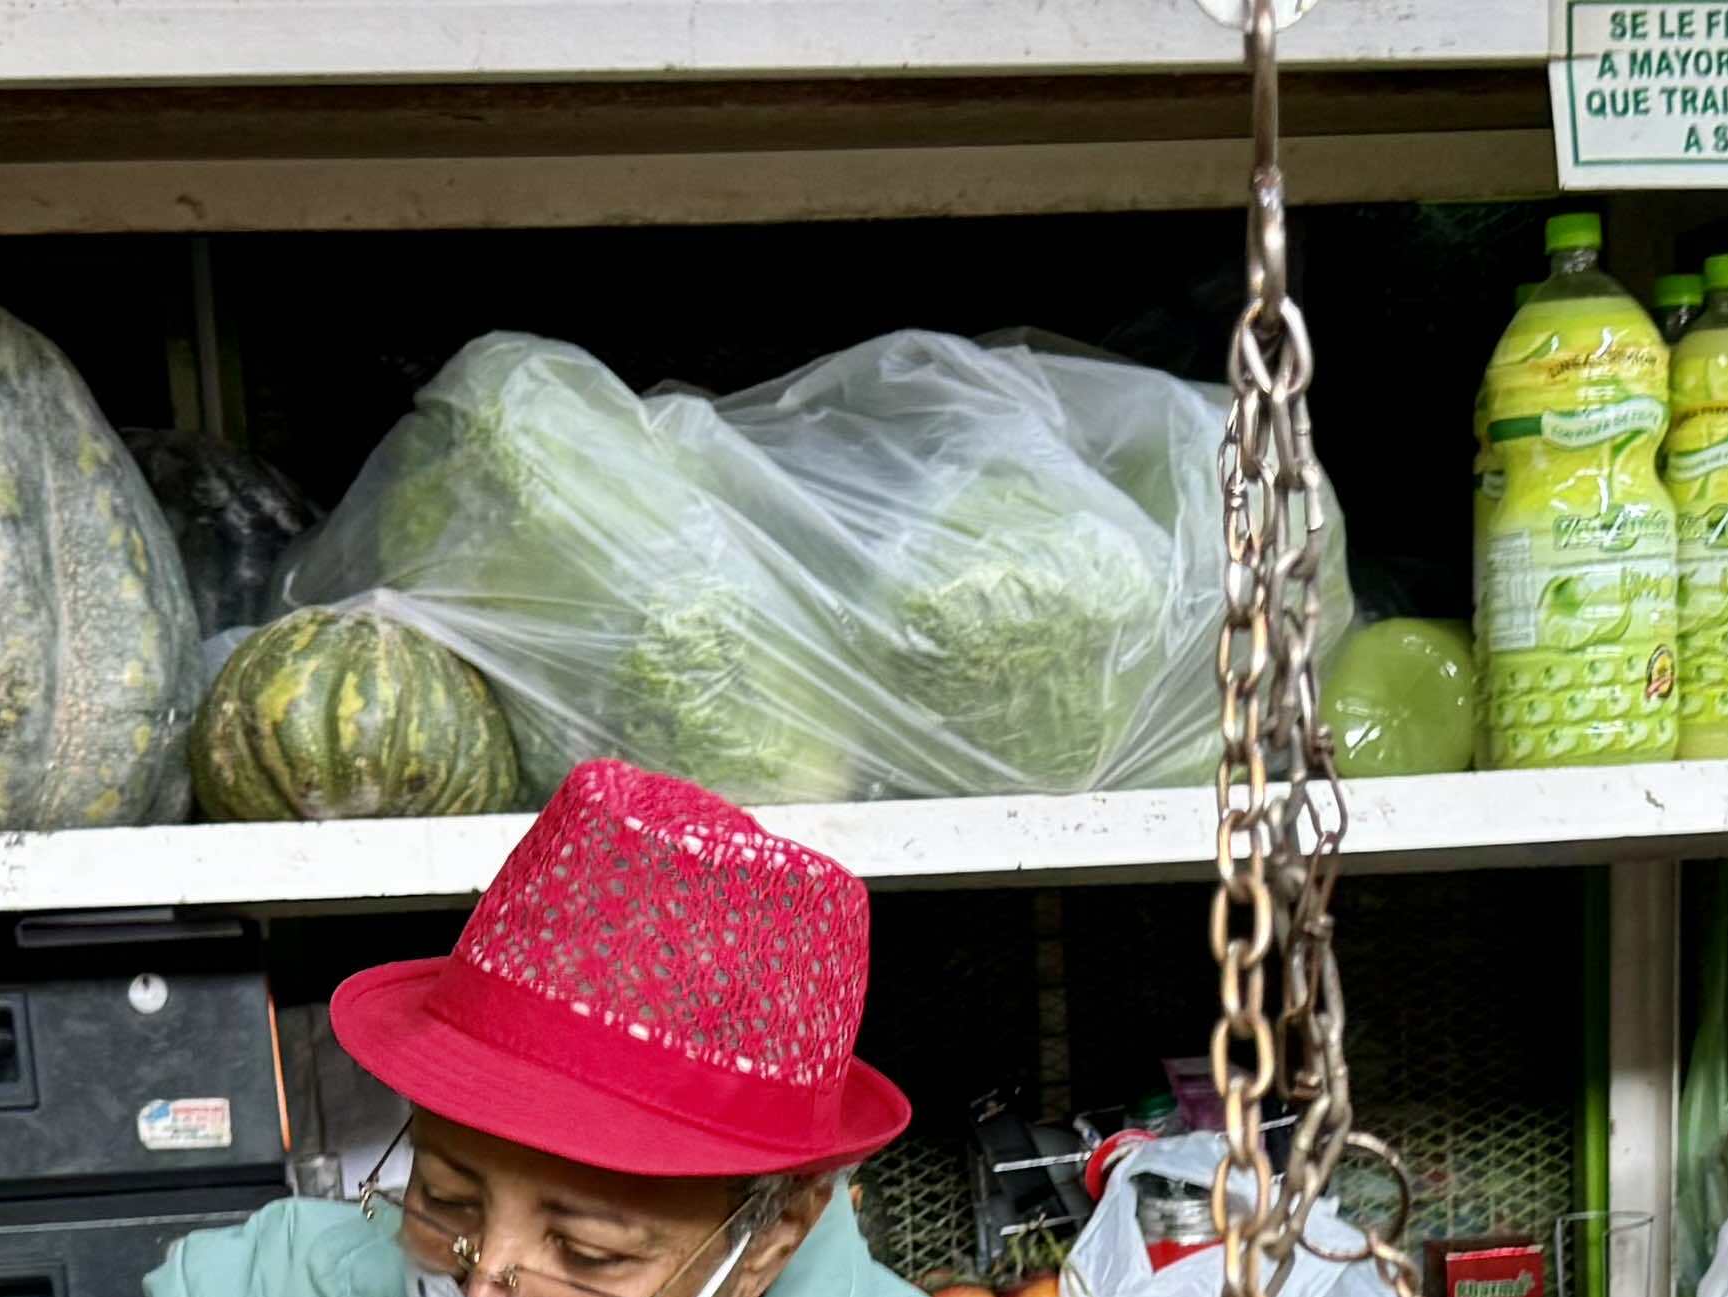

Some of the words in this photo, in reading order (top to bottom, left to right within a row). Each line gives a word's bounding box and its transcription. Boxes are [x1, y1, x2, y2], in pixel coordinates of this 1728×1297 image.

[1609, 10, 1648, 40] SE
[1659, 10, 1696, 39] LE
[1597, 51, 1619, 80] A
[1586, 89, 1650, 118] QUE
[1683, 124, 1703, 153] A
